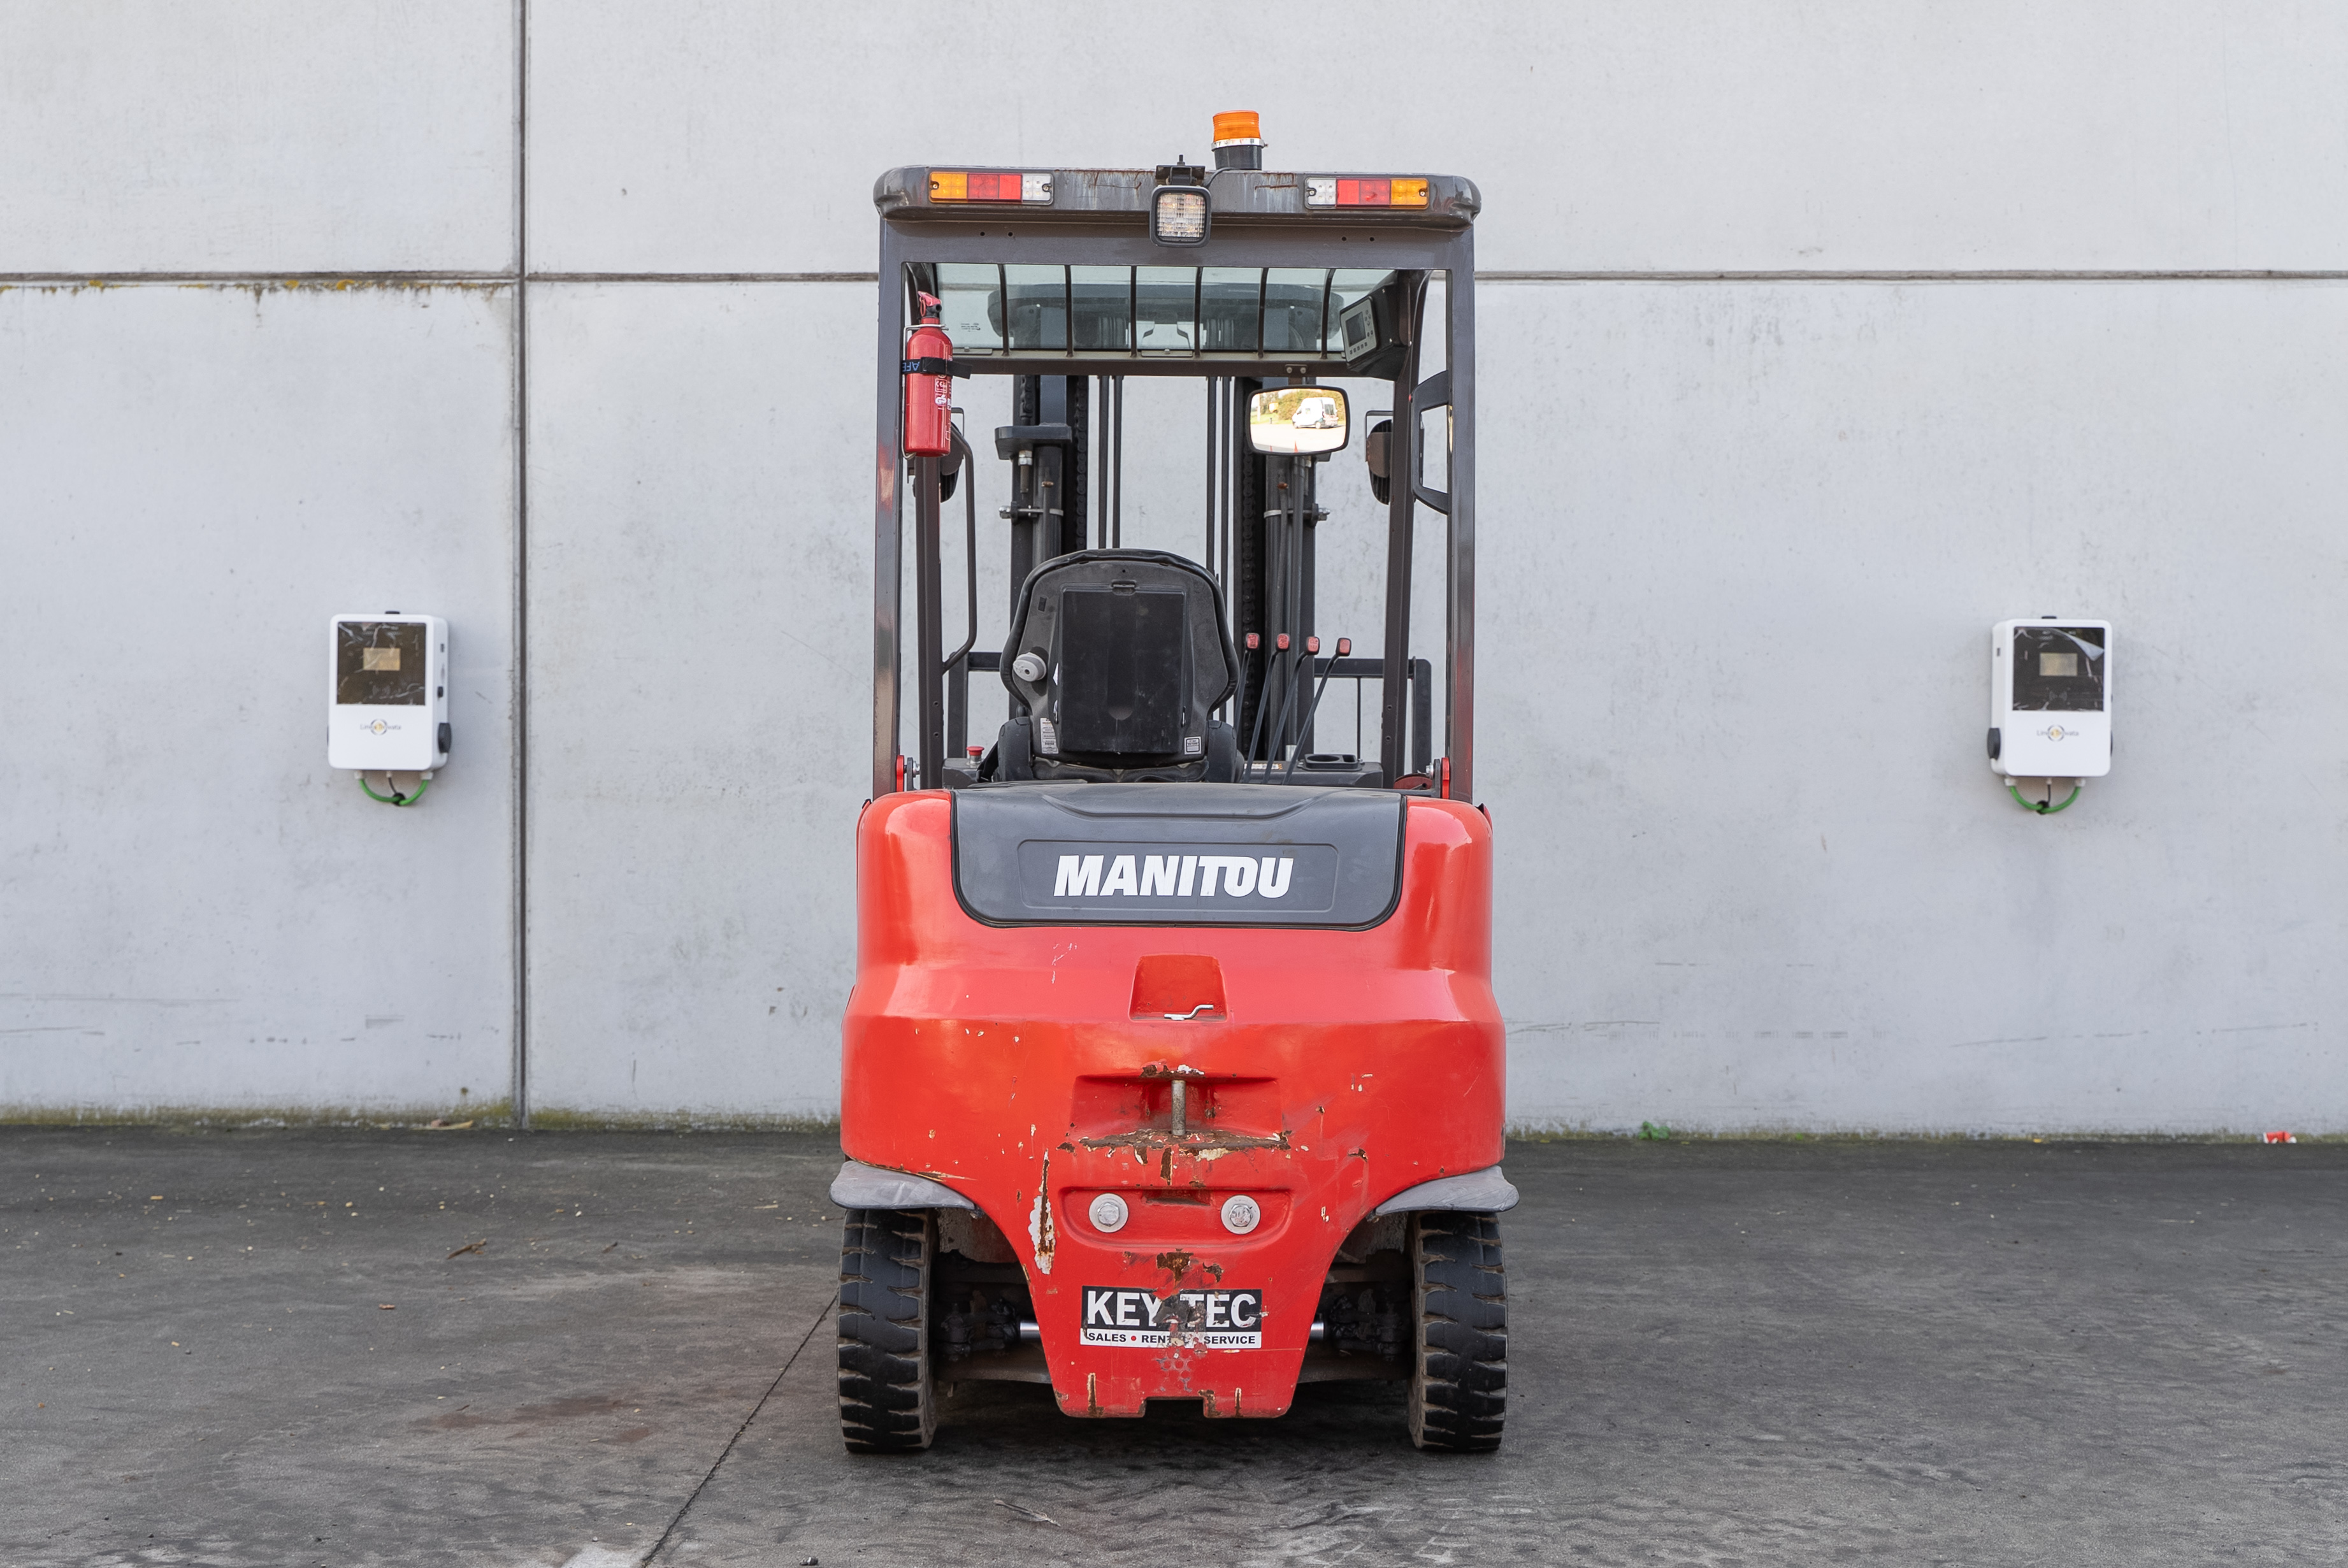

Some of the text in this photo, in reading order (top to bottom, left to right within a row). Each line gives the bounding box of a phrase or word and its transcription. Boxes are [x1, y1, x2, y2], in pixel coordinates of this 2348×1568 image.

[1053, 854, 1294, 898] MANITOU
[1087, 1290, 1163, 1327] KEY
[1088, 1332, 1127, 1342] SALES
[1204, 1335, 1255, 1344] SERVICE
